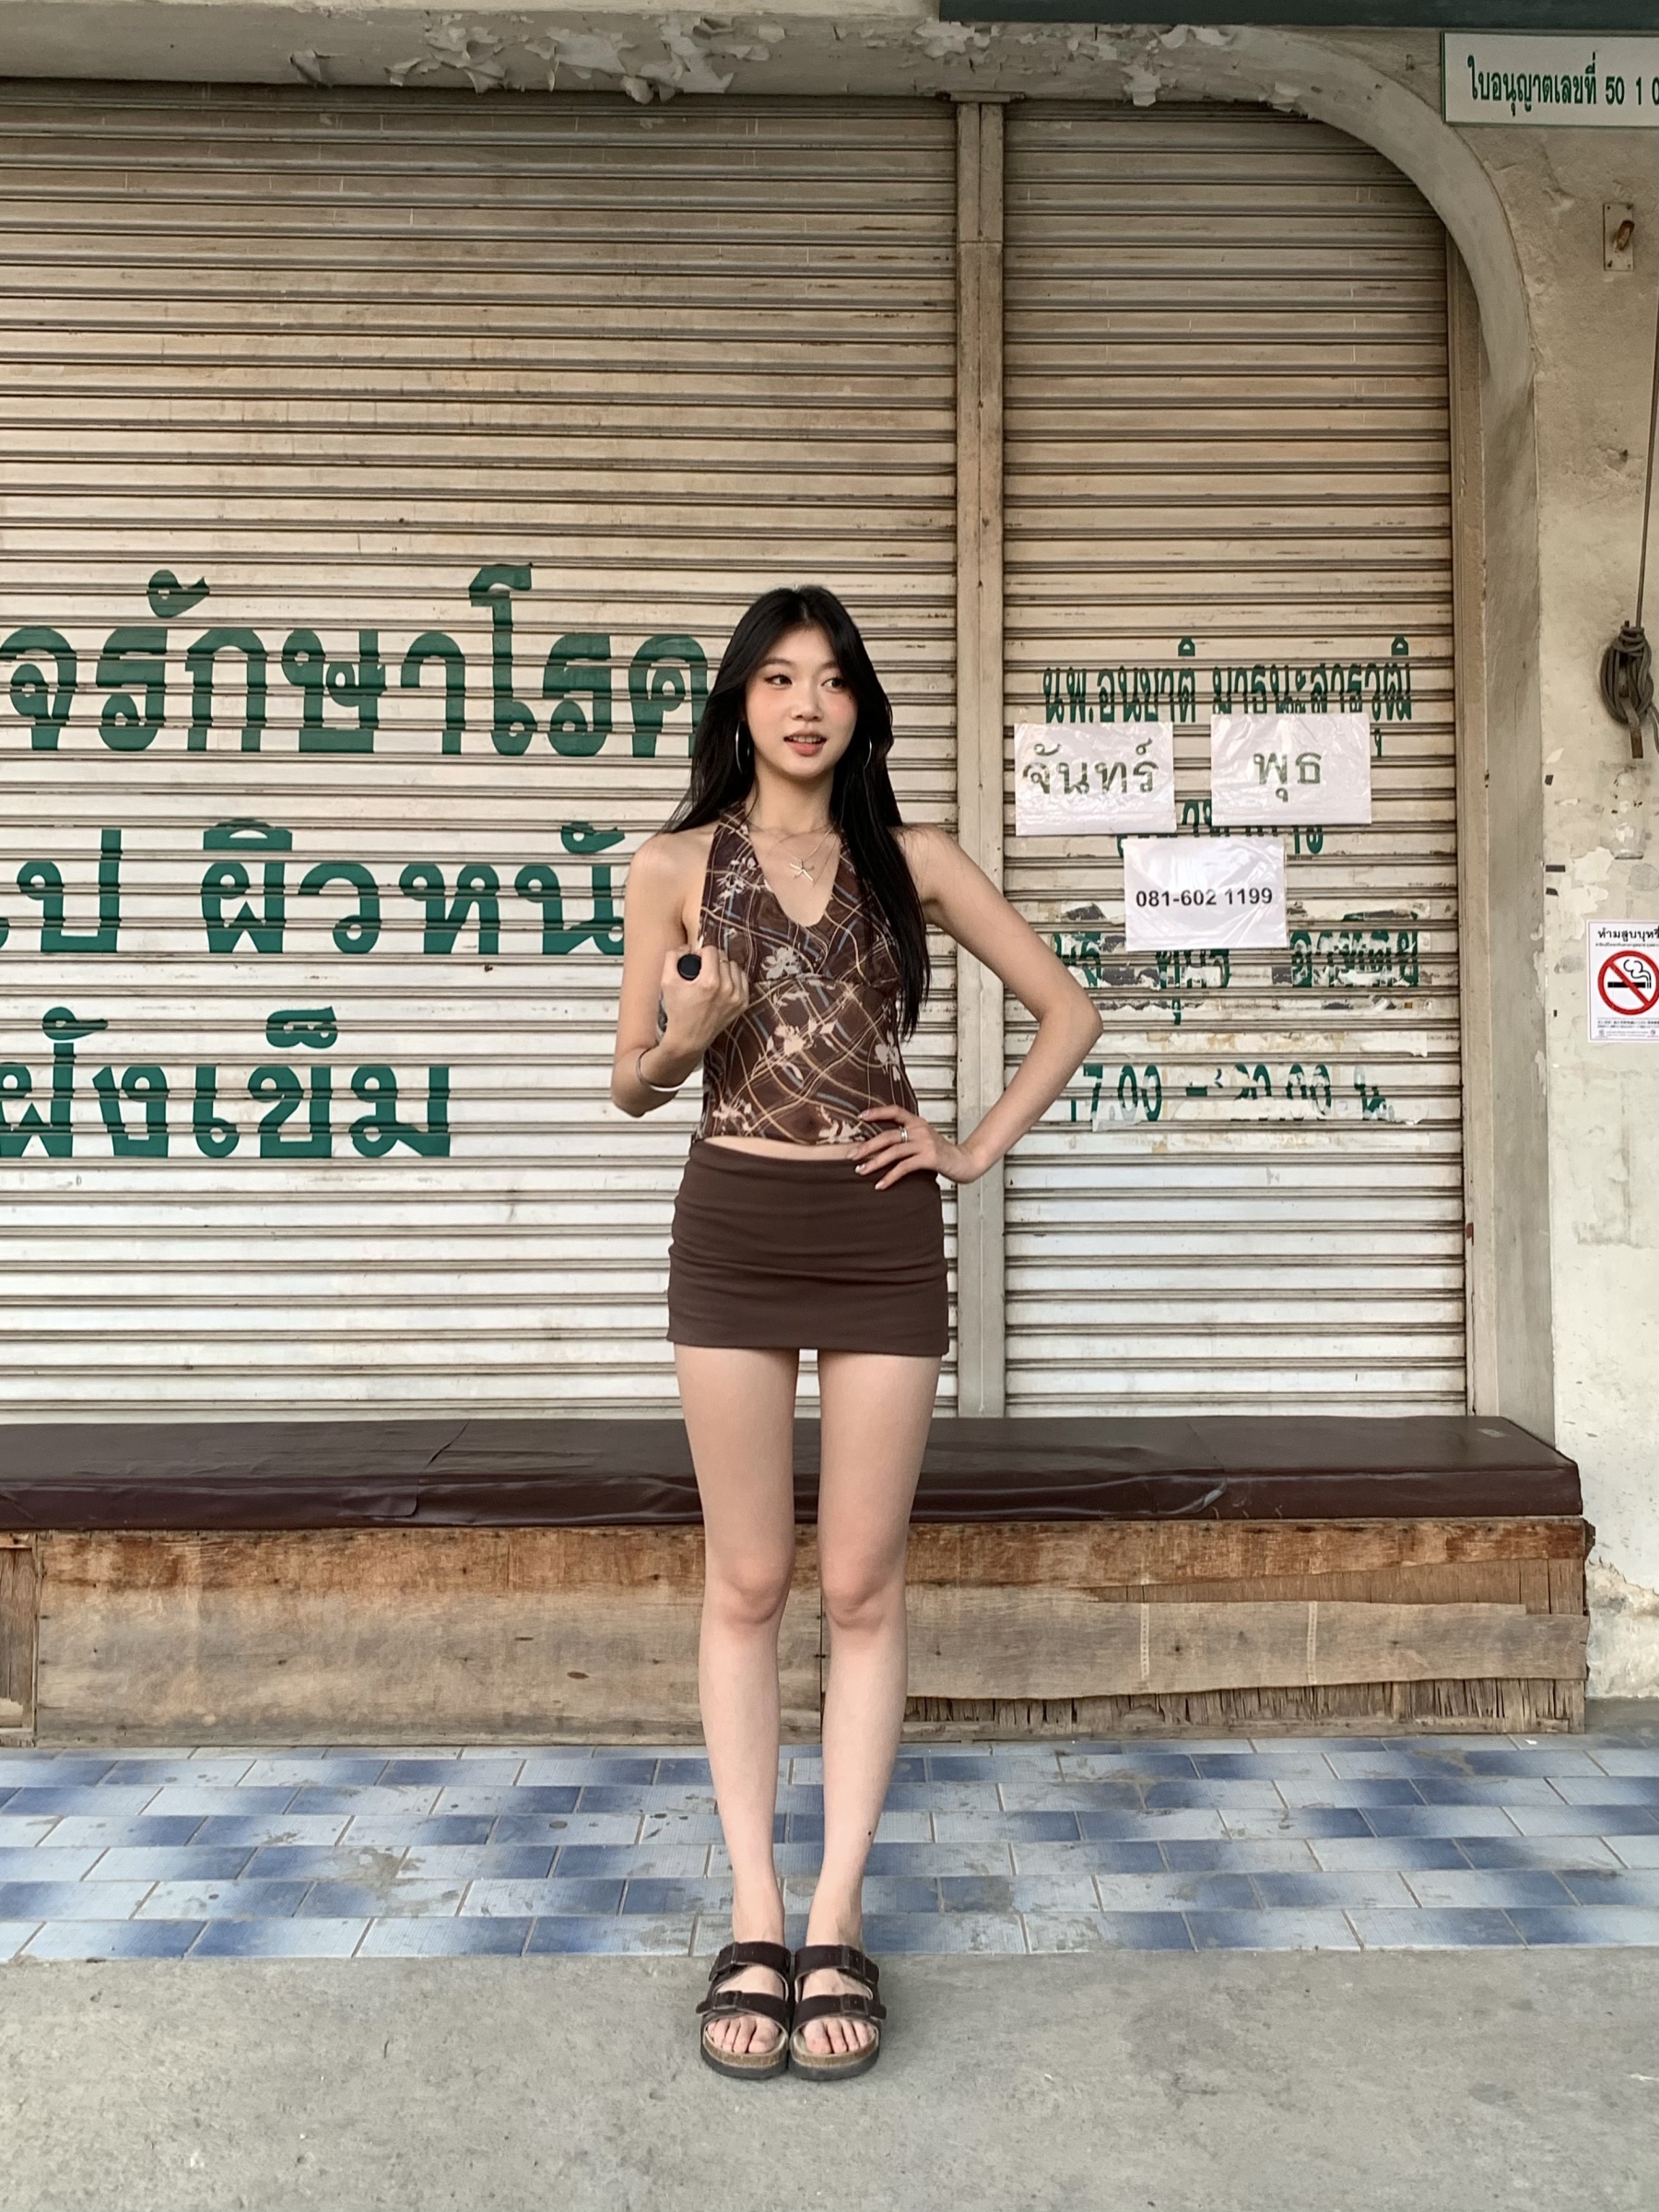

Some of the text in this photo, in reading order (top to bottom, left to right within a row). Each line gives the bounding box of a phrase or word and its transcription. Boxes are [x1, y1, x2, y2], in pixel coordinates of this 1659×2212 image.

[1467, 51, 1596, 116] ใบอนุญาตเลขที่
[1606, 76, 1625, 105] 50
[1042, 636, 1195, 723] นพ.อนชาติ
[1022, 738, 1159, 794] จันทร์
[1252, 751, 1322, 802] พุธ
[0, 818, 626, 955] ป ผิวหนั
[1135, 888, 1273, 907] 081-602 1199
